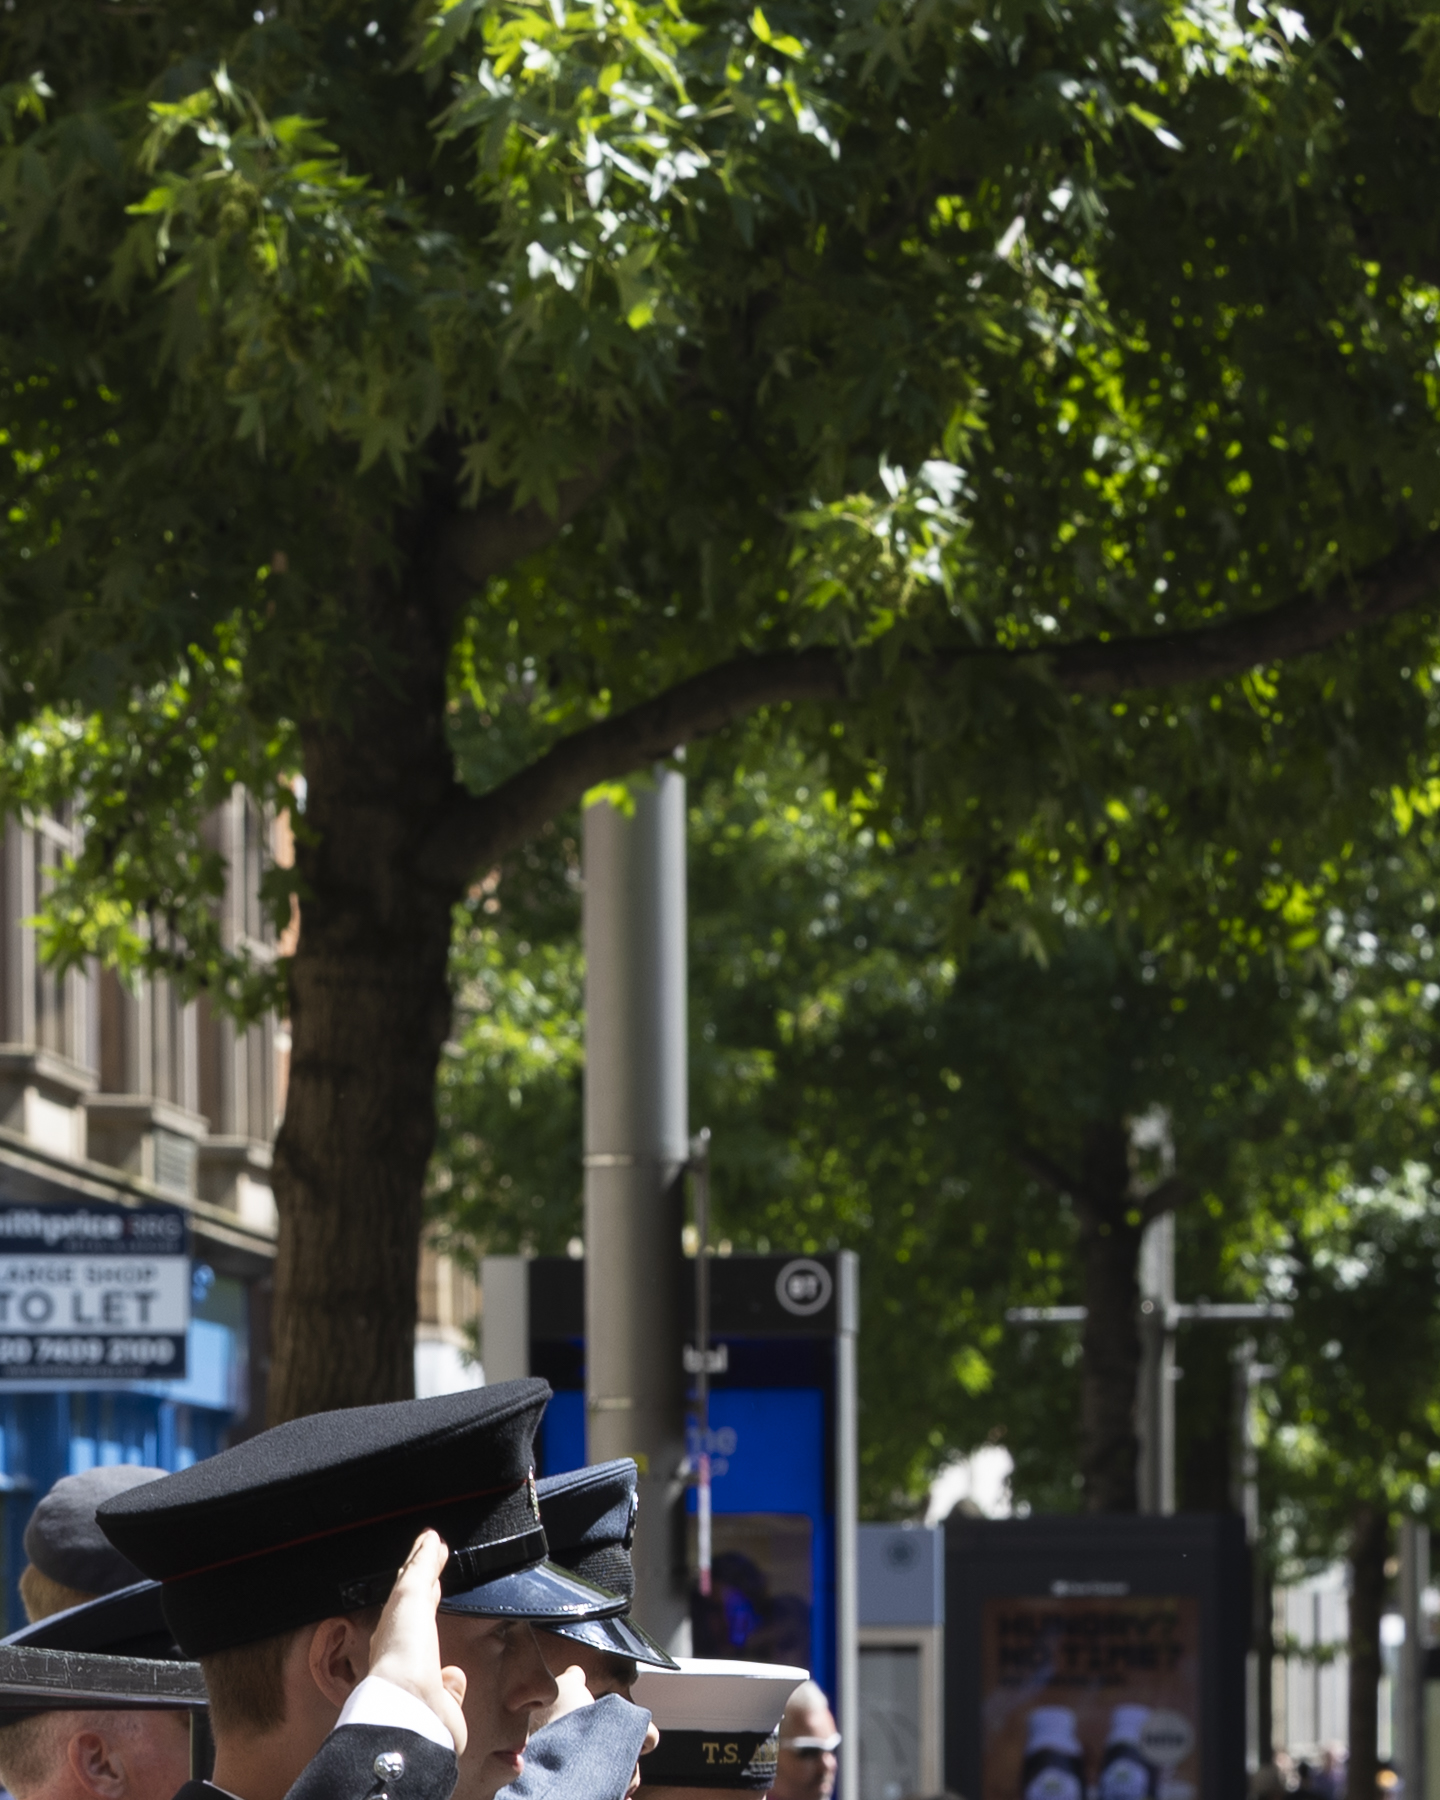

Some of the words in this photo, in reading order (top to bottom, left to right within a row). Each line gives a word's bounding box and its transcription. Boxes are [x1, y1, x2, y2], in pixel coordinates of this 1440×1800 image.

[86, 1265, 159, 1285] SHOP
[788, 1274, 818, 1299] BT
[71, 1290, 158, 1324] LET
[702, 1742, 741, 1764] T.S.
